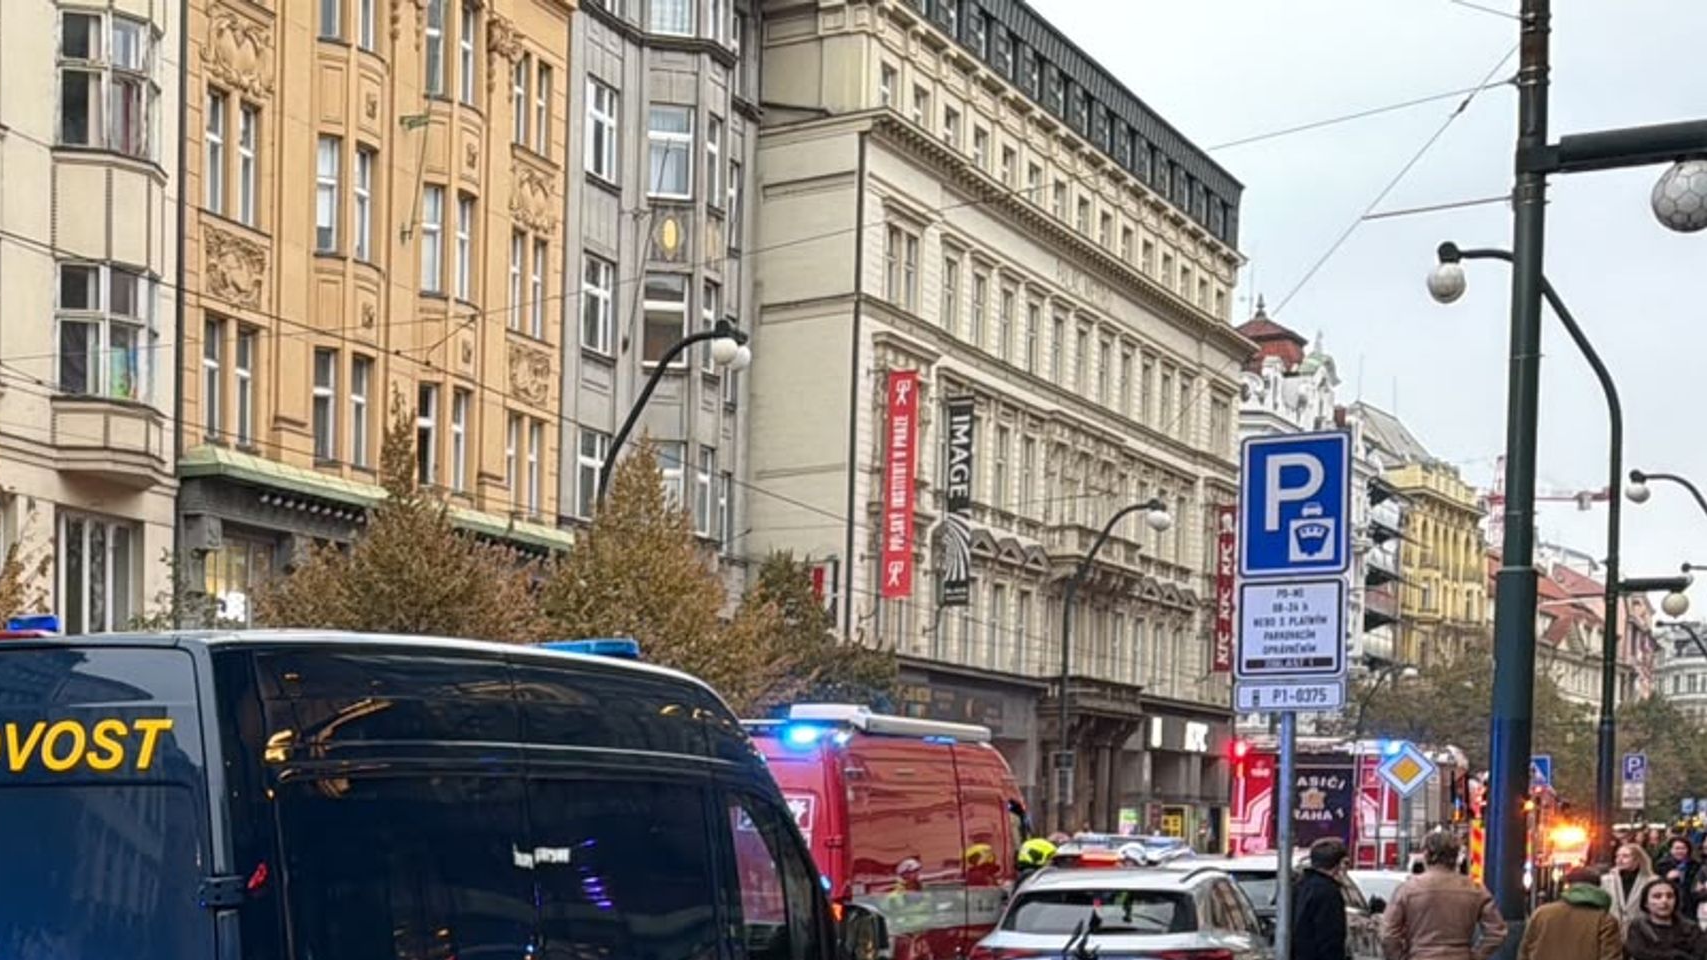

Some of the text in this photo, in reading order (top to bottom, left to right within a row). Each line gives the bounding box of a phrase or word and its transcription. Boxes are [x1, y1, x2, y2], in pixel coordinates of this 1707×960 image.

[949, 415, 971, 498] IMAGE
[1265, 452, 1325, 531] P
[1216, 631, 1229, 665] KFC
[1628, 758, 1641, 773] P
